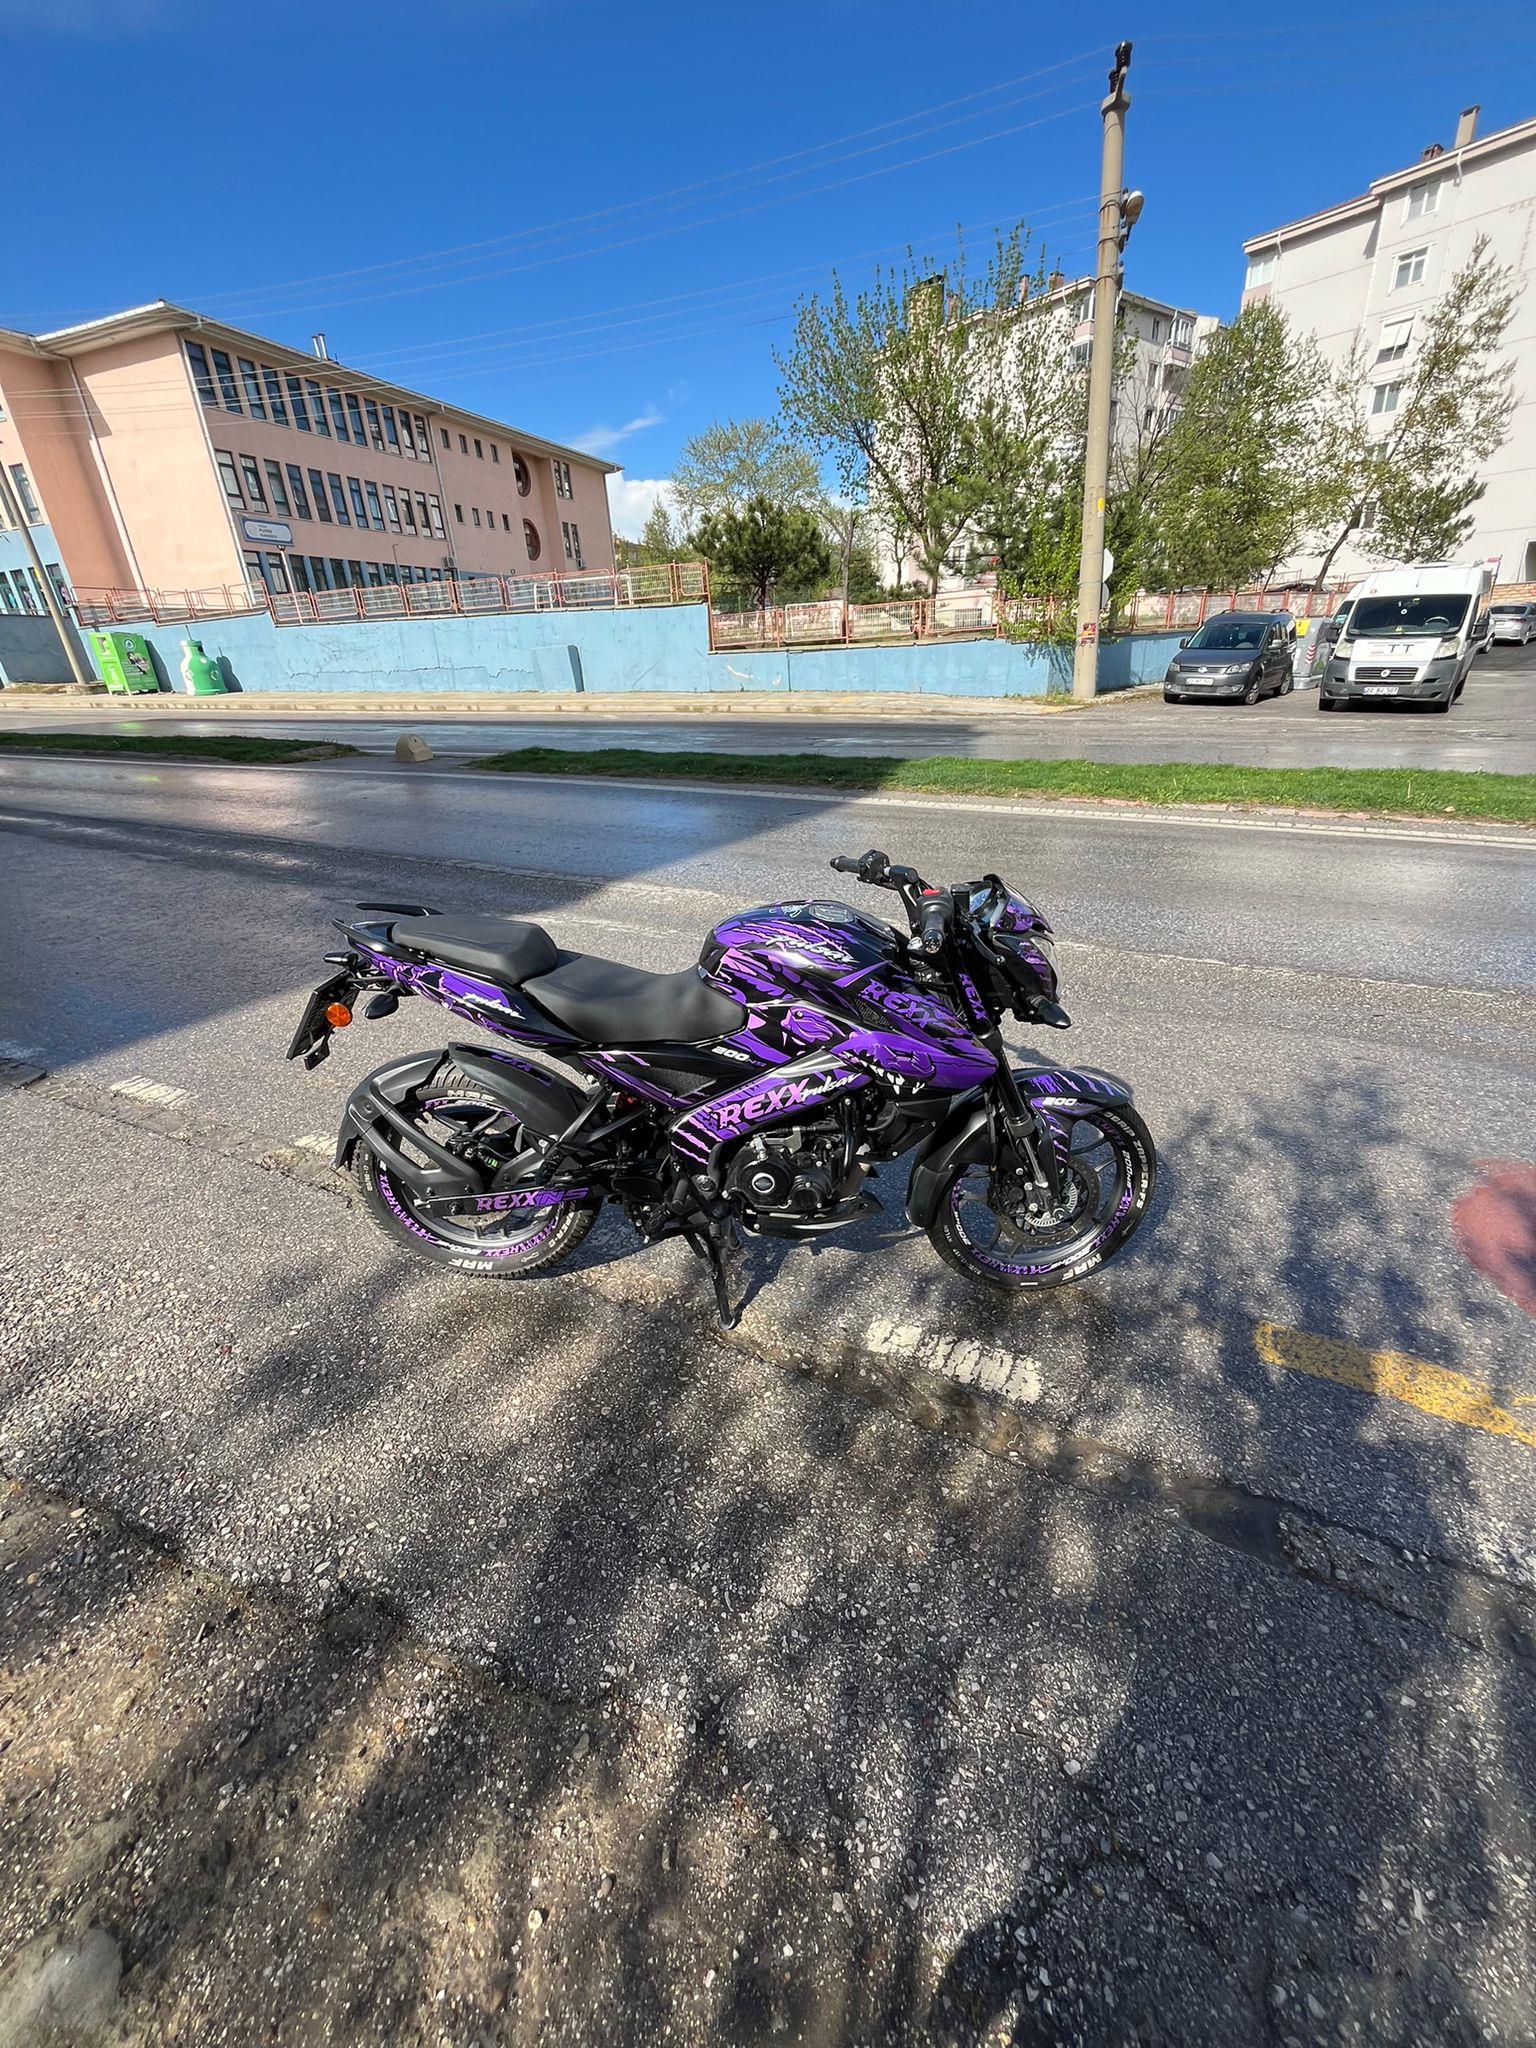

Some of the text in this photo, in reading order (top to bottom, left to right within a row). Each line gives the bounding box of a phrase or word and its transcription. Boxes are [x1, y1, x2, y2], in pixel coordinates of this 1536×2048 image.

[860, 978, 932, 1028] REXX
[958, 973, 986, 1020] REXX
[716, 1078, 810, 1129] REXX
[475, 1190, 540, 1211] REXX
[448, 1258, 494, 1271] MRF
[1062, 1253, 1102, 1281] MRF
